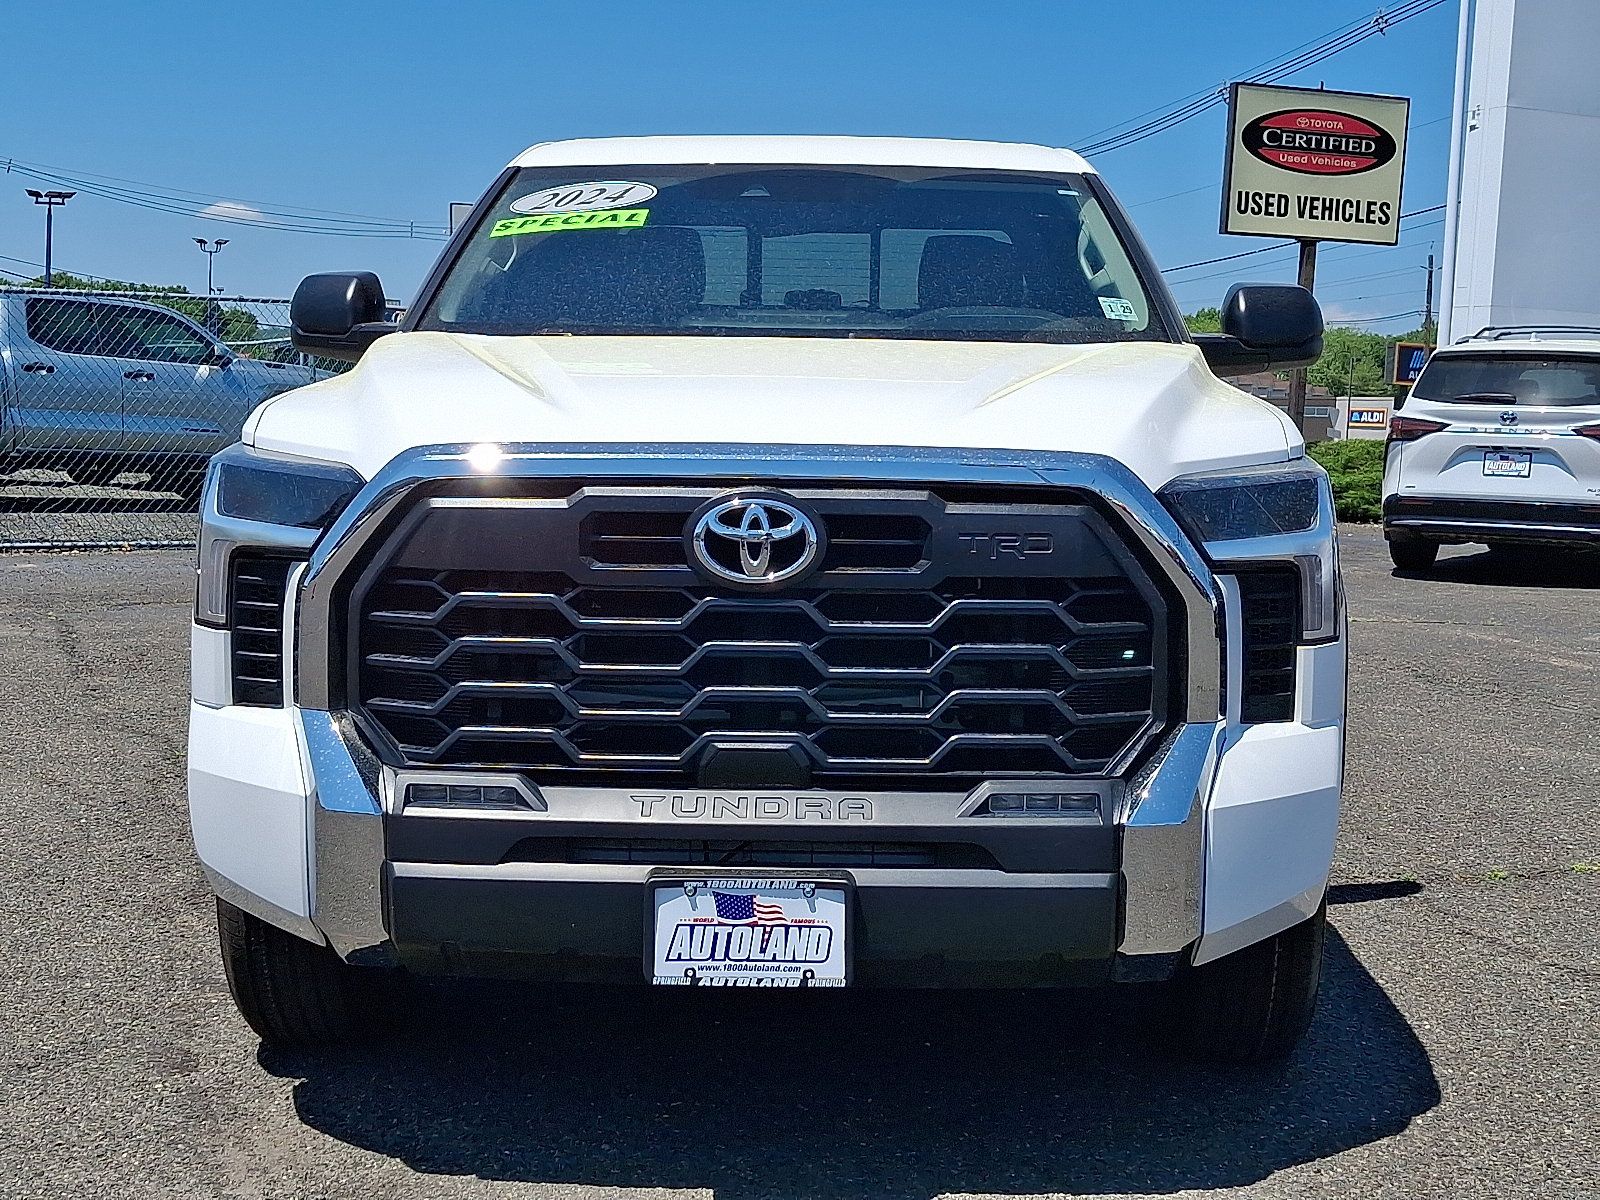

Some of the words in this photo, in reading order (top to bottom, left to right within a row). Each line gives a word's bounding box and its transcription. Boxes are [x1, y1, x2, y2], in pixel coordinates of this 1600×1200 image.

[1309, 119, 1344, 130] TOYOTA
[1279, 153, 1308, 164] Used
[1311, 156, 1357, 168] Vehicles
[529, 186, 637, 211] 2024
[1236, 190, 1290, 217] USED
[1296, 195, 1392, 225] VEHICLES
[495, 213, 640, 232] SPECIAL
[1107, 304, 1115, 313] 1
[1360, 411, 1384, 423] ALDI
[958, 532, 1054, 560] TRD
[630, 795, 873, 820] TUNDRA
[665, 925, 833, 963] AUTOLAND
[697, 964, 802, 973] www.1800Autoland.com
[698, 977, 800, 987] AUTOLAND
